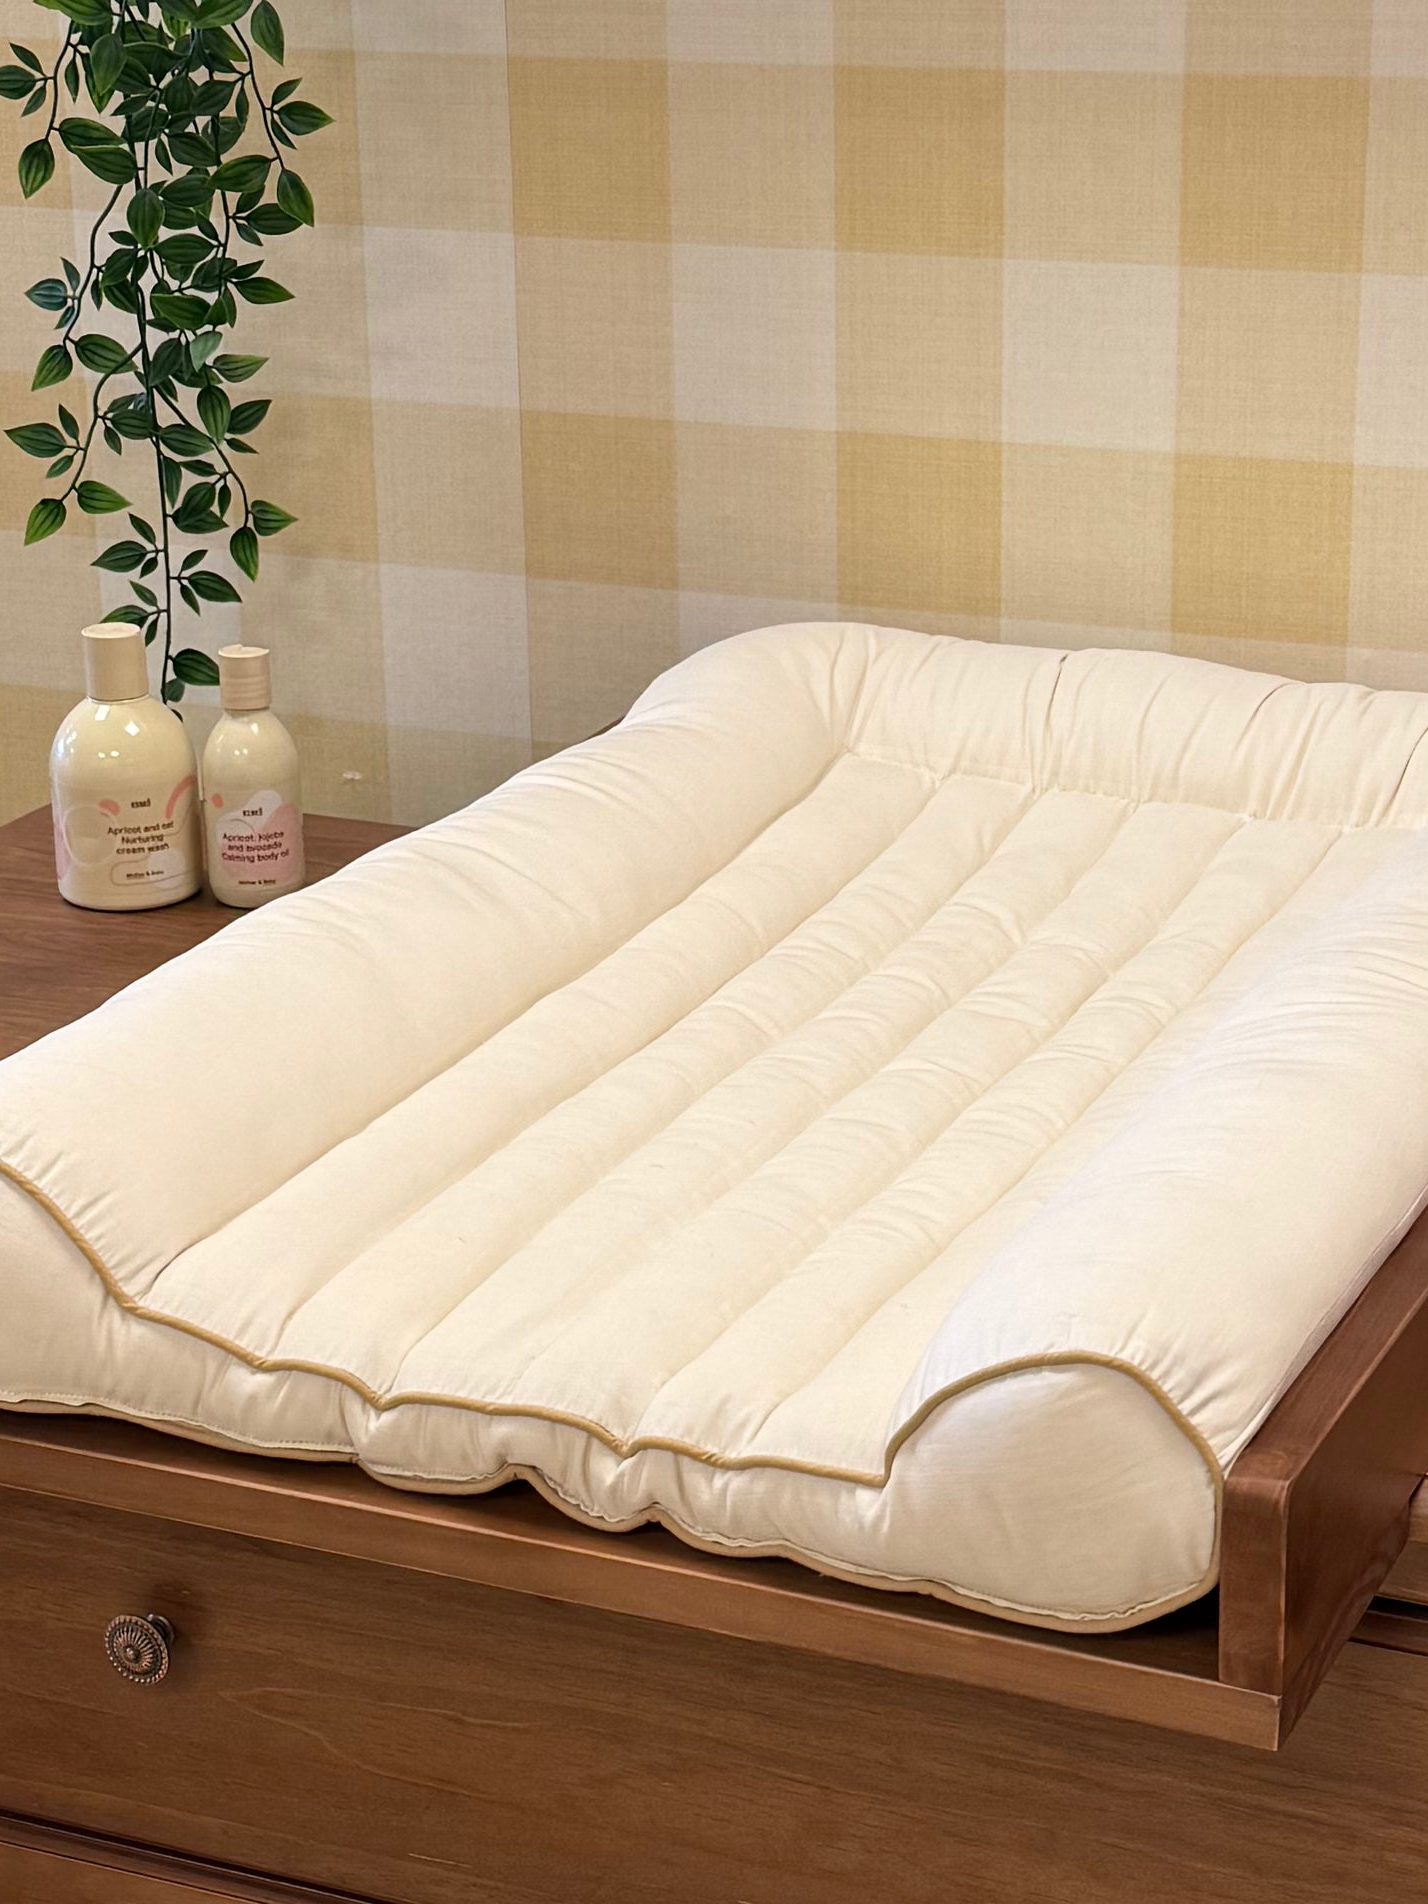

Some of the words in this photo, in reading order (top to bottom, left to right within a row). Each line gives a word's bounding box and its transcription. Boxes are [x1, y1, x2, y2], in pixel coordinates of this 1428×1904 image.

[107, 826, 142, 836] Apricot
[143, 823, 160, 833] and
[121, 834, 164, 844] Nurturing
[116, 846, 146, 854] cream
[227, 844, 244, 852] and
[221, 852, 255, 863] Calming
[257, 851, 279, 862] body
